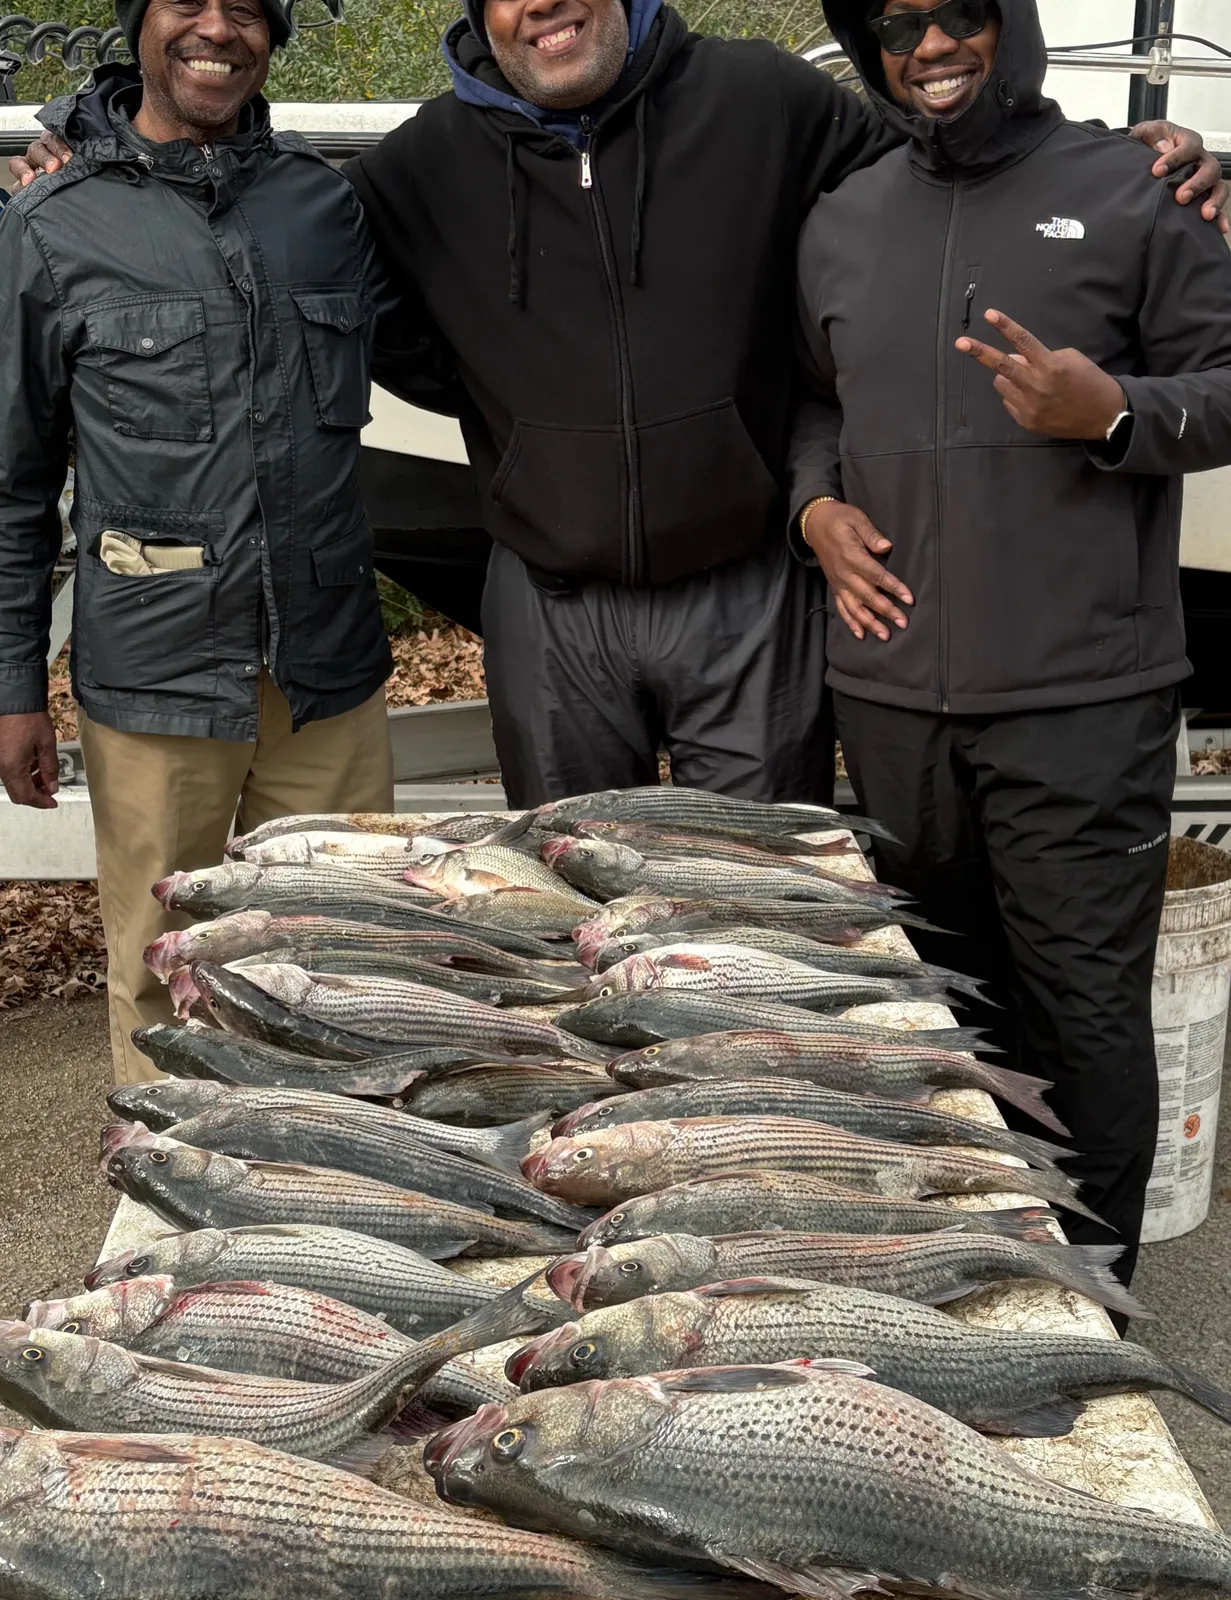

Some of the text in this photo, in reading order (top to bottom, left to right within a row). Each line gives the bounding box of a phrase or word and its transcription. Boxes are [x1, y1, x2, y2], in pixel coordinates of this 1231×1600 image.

[1051, 216, 1070, 225] THE
[1035, 223, 1069, 233] NORTH
[1043, 230, 1067, 239] FACE
[1128, 844, 1147, 854] FIELD
